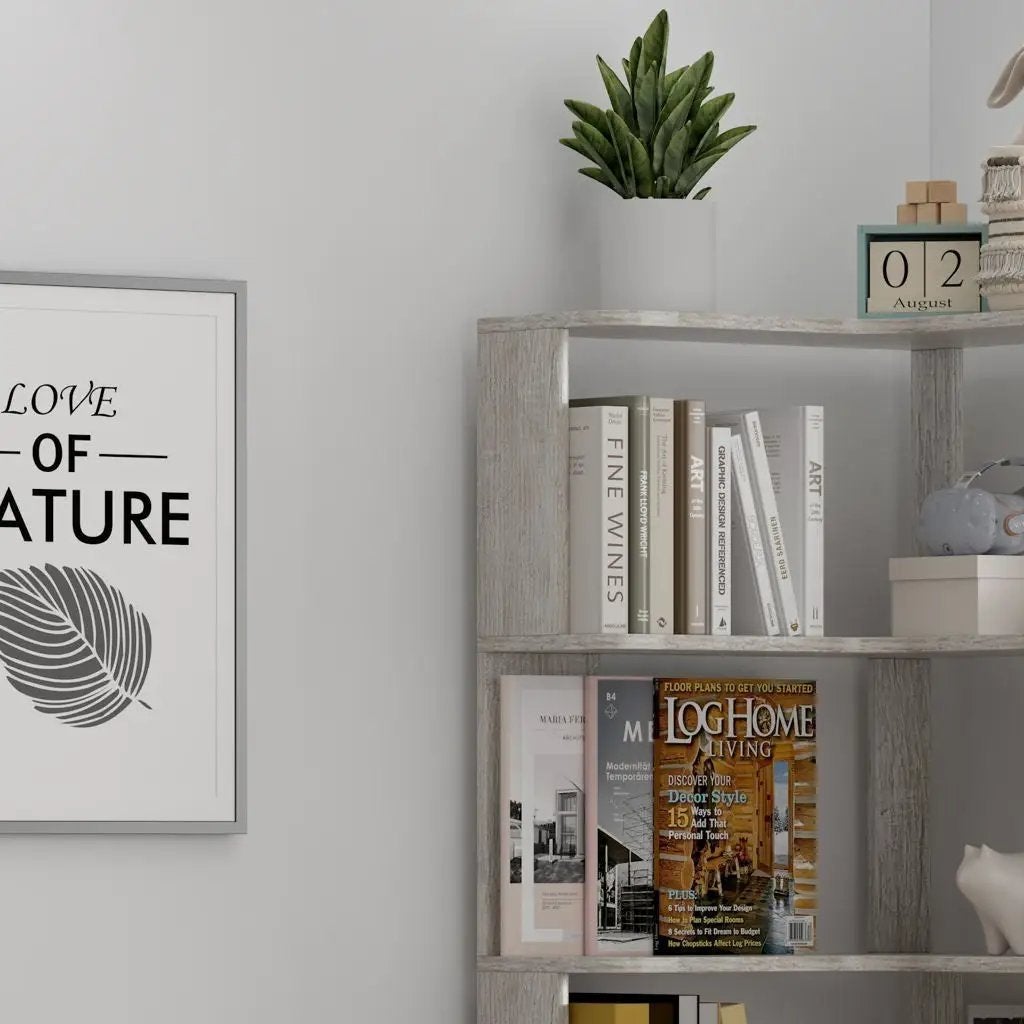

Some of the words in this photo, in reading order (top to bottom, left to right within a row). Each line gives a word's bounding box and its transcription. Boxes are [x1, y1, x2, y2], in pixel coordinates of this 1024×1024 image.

[893, 297, 952, 311] August
[1, 381, 118, 418] LOVE
[32, 432, 91, 473] OF
[607, 438, 624, 498] FINE
[690, 455, 704, 492] ART
[718, 446, 726, 489] GRAPHIC
[640, 470, 648, 496] FRANK
[809, 460, 822, 497] ART
[640, 498, 648, 524] LLOYD
[718, 492, 726, 528] DESIGN
[640, 525, 648, 558] WRIGHT
[607, 512, 624, 603] WINES
[718, 531, 726, 595] REFERENCED
[664, 682, 692, 692] FLOOR
[694, 682, 722, 693] PLANS
[724, 683, 736, 693] TO
[738, 683, 754, 693] GET
[756, 683, 774, 693] YOU
[776, 684, 813, 693] STARTED
[540, 714, 566, 724] MARIA
[709, 741, 771, 757] LIVING
[668, 775, 707, 786] DISCOVER
[710, 774, 731, 786] YOUR
[668, 790, 708, 803] Decor
[711, 790, 747, 807] Style
[668, 807, 689, 828] 15
[690, 807, 711, 818] Ways
[714, 807, 722, 815] to
[691, 818, 707, 828] Add
[710, 818, 727, 828] That
[668, 830, 703, 839] Personal
[705, 830, 729, 839] Touch
[695, 904, 718, 913] Improve
[734, 904, 752, 913] Design
[725, 916, 744, 924] Rooms
[740, 928, 760, 936] Budget
